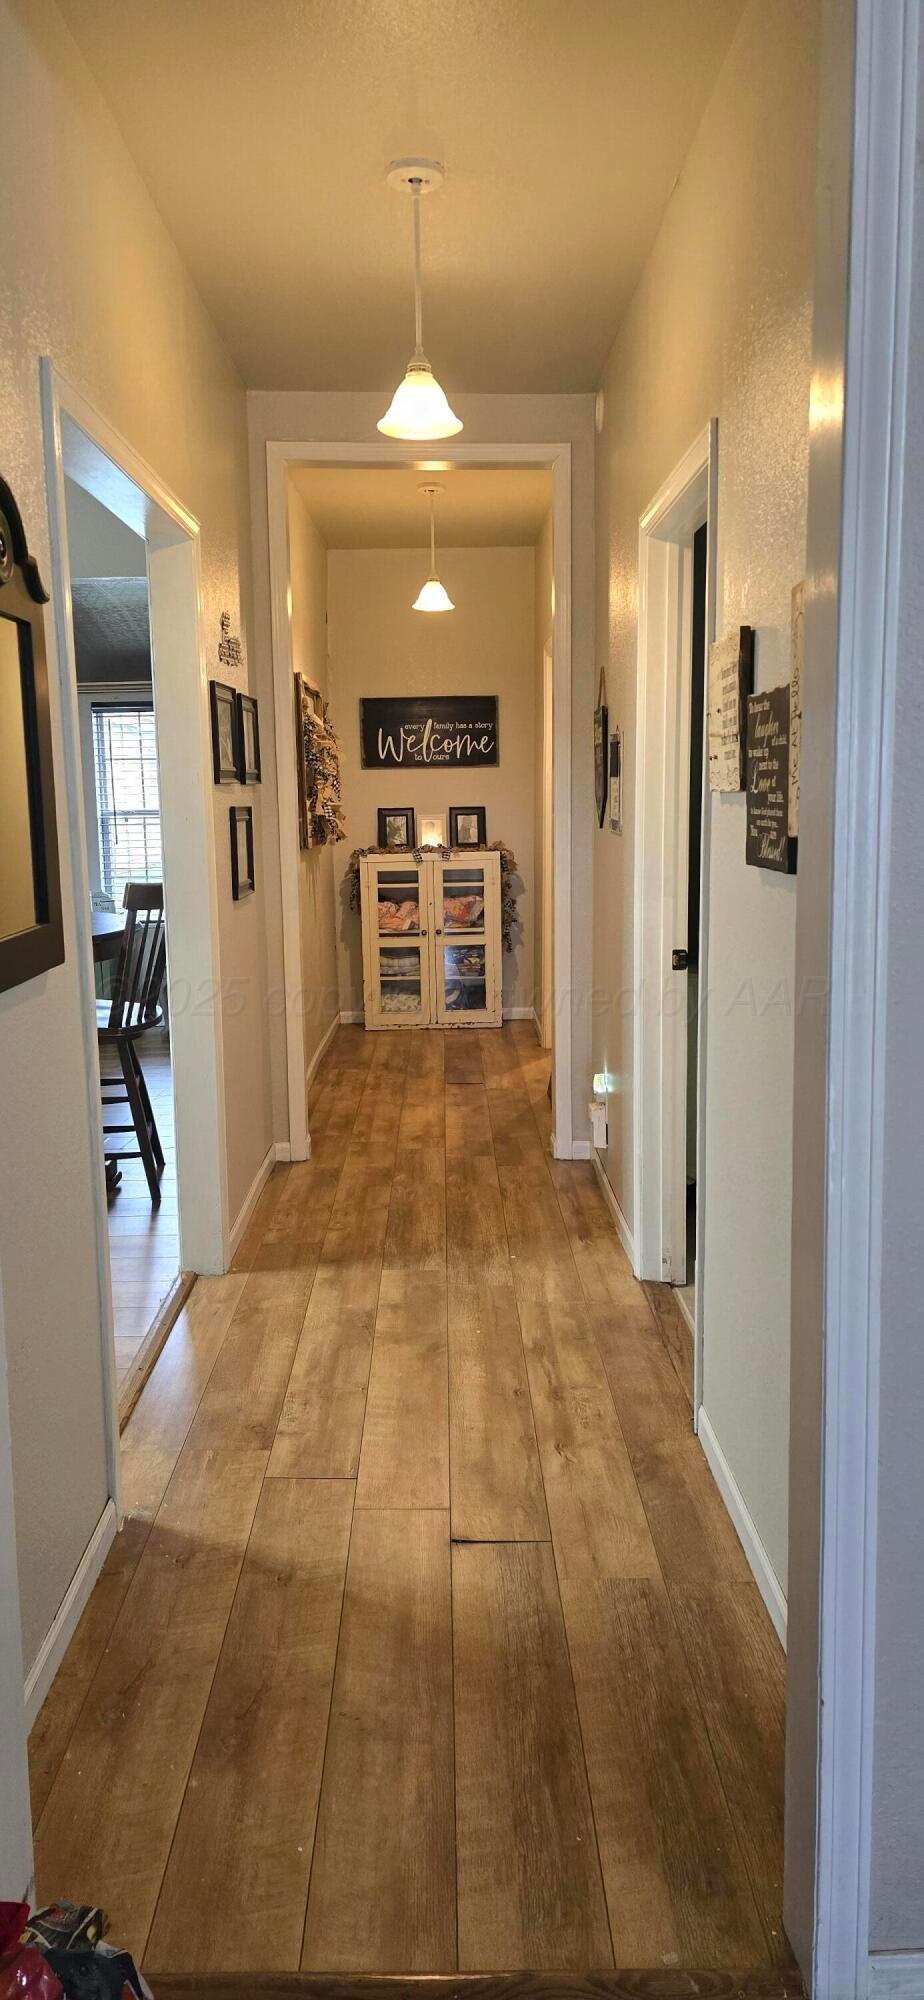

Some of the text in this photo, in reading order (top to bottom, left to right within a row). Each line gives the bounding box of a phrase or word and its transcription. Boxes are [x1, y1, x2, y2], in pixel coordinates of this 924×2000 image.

[404, 722, 425, 732] every
[433, 722, 454, 732] family
[475, 722, 493, 731] story
[378, 718, 494, 762] Welcome
[414, 753, 422, 761] to
[750, 758, 770, 794] Love
